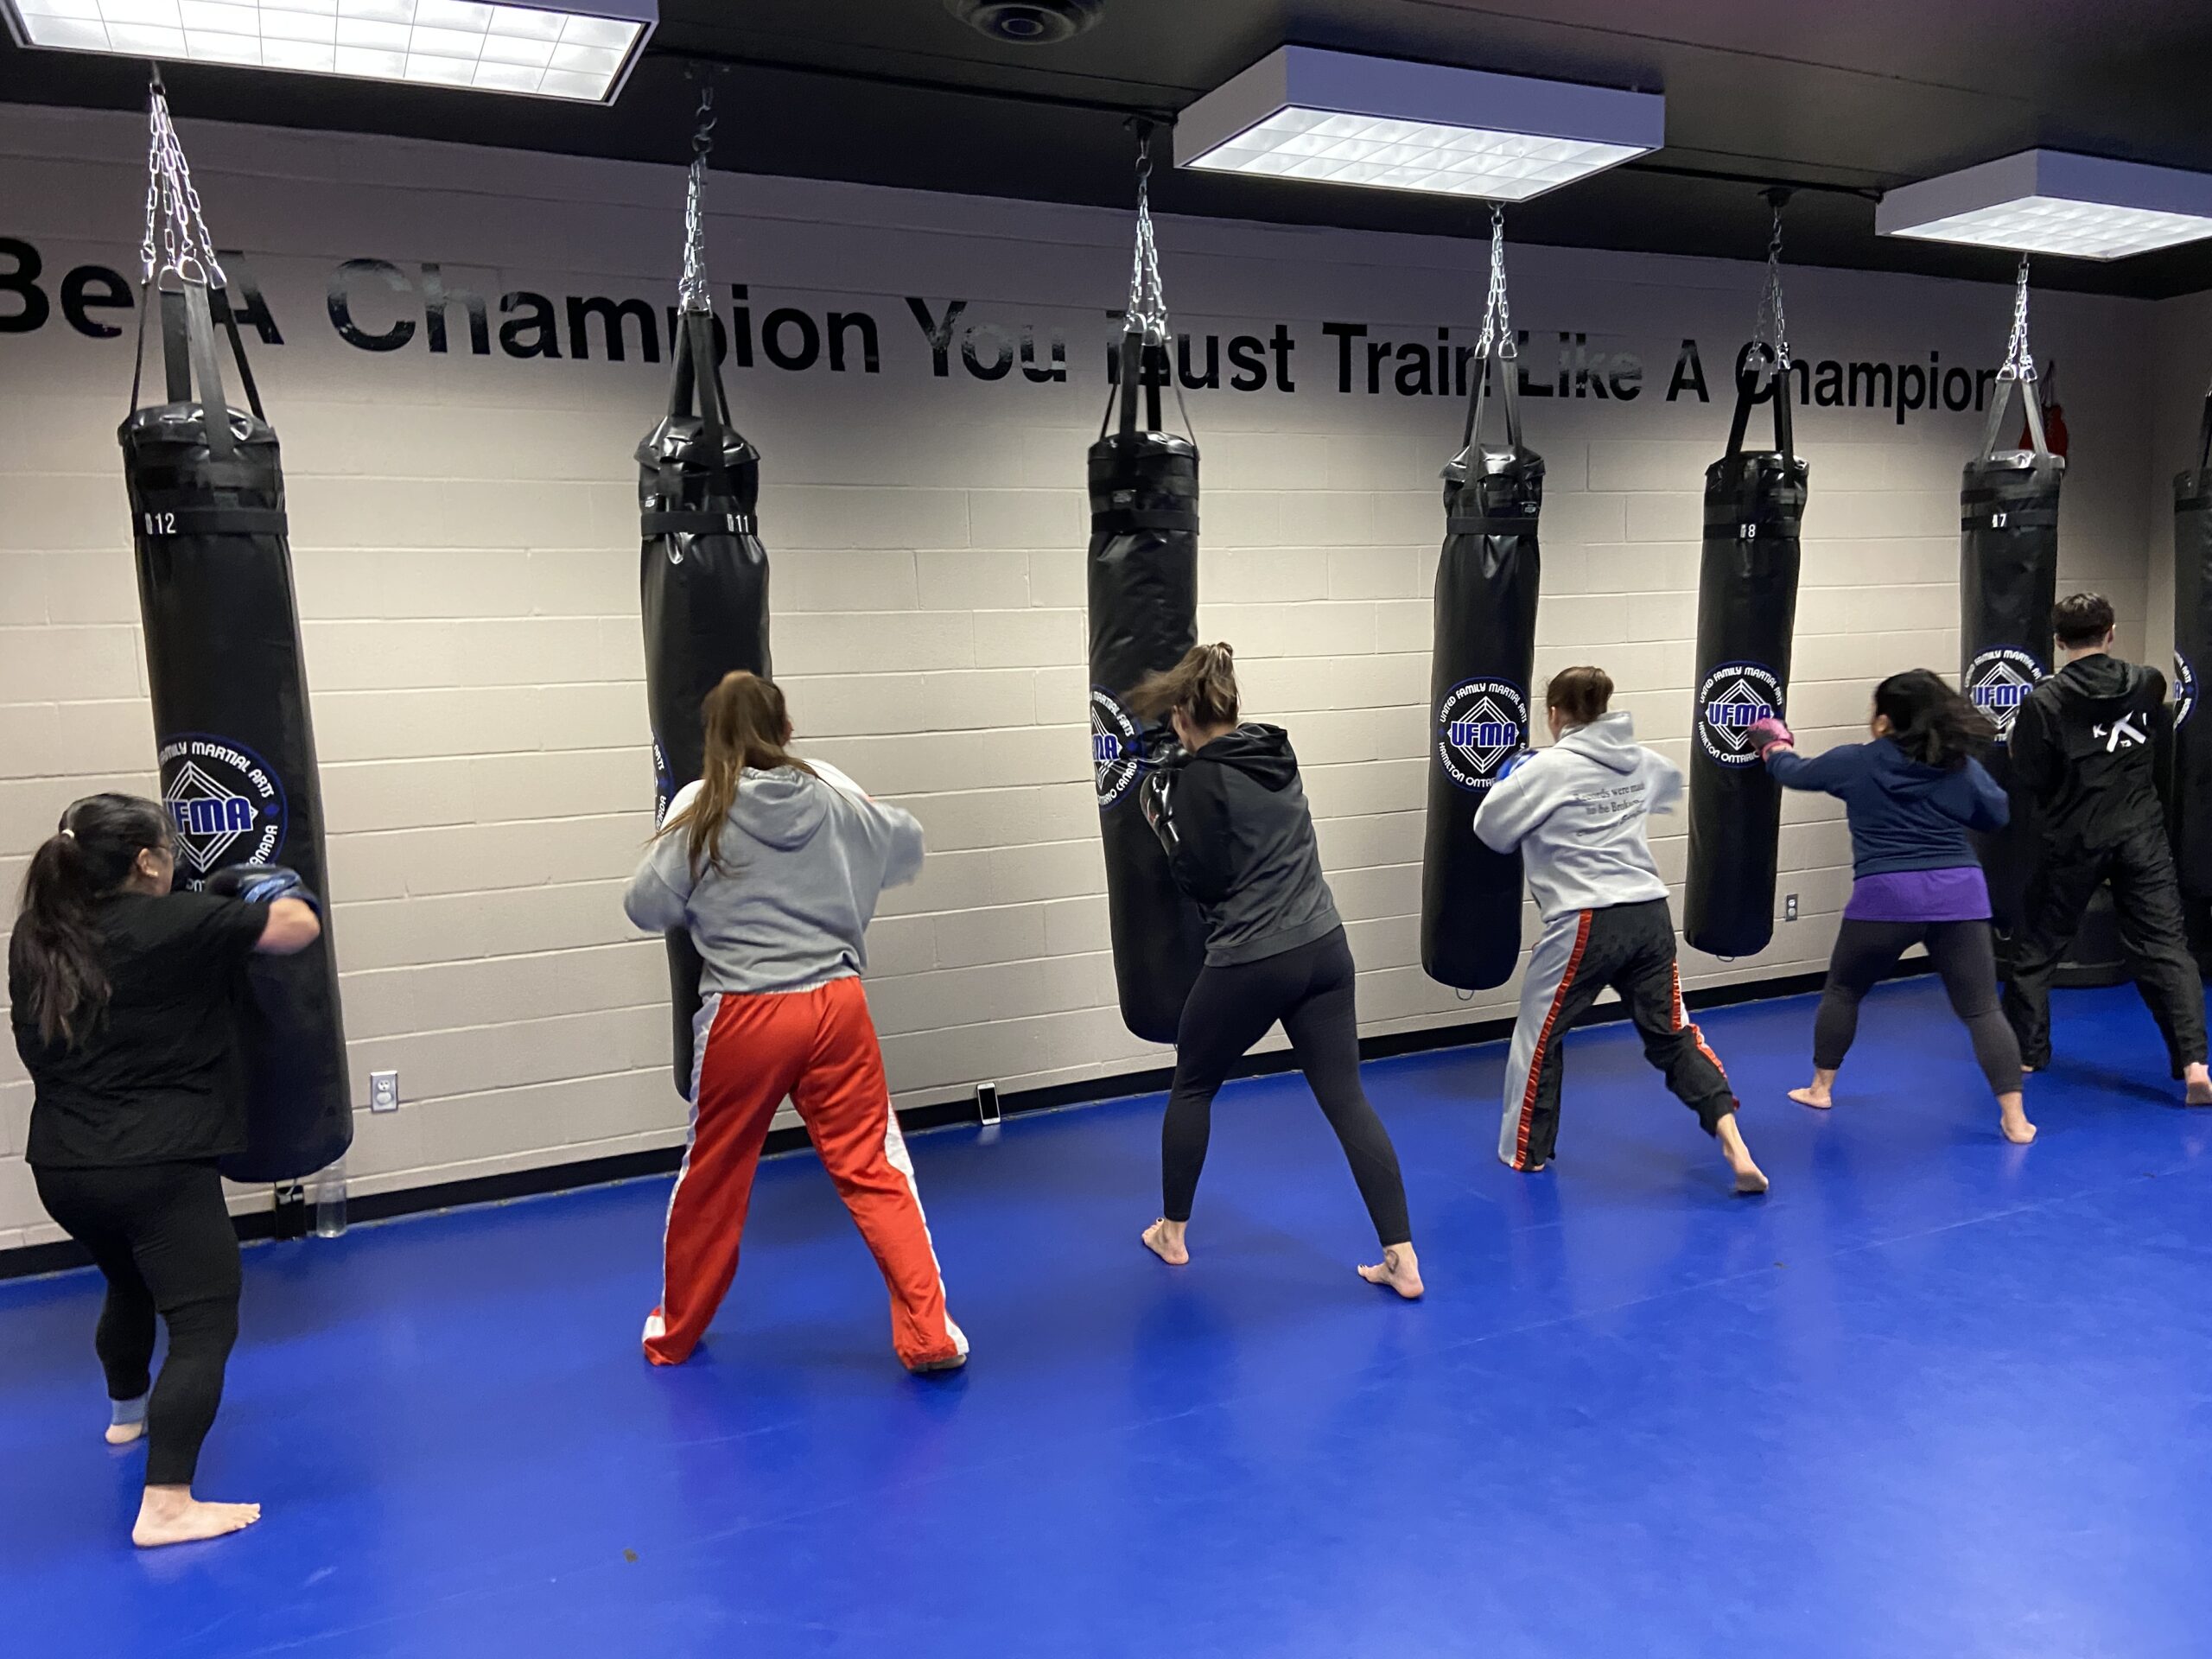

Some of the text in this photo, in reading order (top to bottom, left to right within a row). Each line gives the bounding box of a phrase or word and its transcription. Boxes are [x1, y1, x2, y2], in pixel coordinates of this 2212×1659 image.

[0, 238, 135, 340] Be
[905, 296, 1067, 383] You
[1518, 329, 1643, 401] Like
[1666, 338, 1711, 404] A
[1440, 682, 1528, 724] UNITED FAMILY MARTIAL ARTS
[1699, 678, 1714, 704] UNITED
[1713, 666, 1743, 683] FAMILY
[1744, 666, 1778, 689] MARTIAL
[1450, 721, 1517, 748] UFMA
[1698, 721, 1721, 759] HAMILTON
[192, 741, 251, 772] MARTIAL
[247, 768, 275, 798] ARTS
[1116, 760, 1137, 791] CANAD
[1439, 741, 1496, 788] HAMILTON ONTA
[245, 824, 278, 867] ANADA
